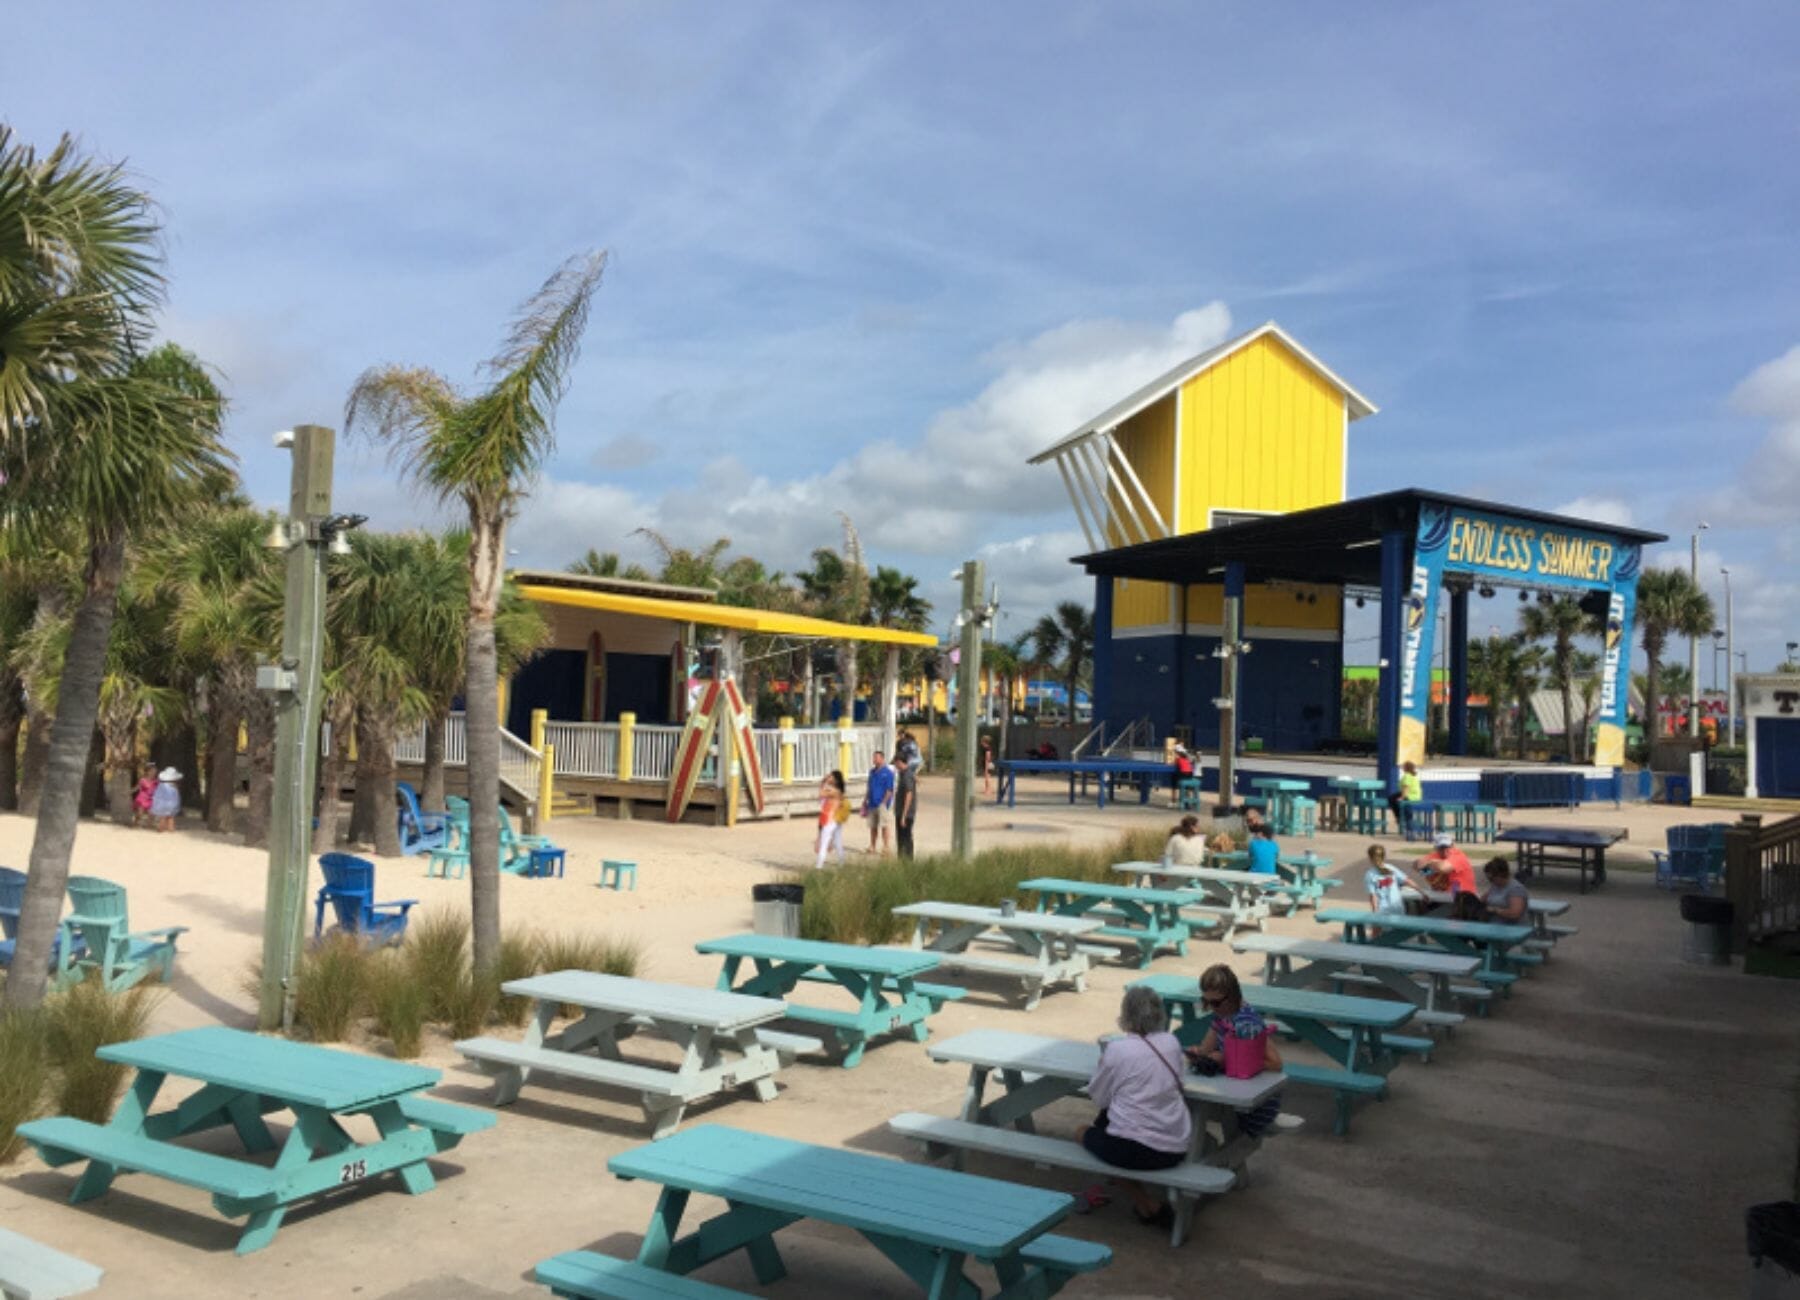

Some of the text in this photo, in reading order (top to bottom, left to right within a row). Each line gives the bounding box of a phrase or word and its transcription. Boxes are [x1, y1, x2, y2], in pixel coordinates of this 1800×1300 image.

[1448, 517, 1613, 582] ENDLESS SUMMER
[341, 1159, 366, 1182] 215
